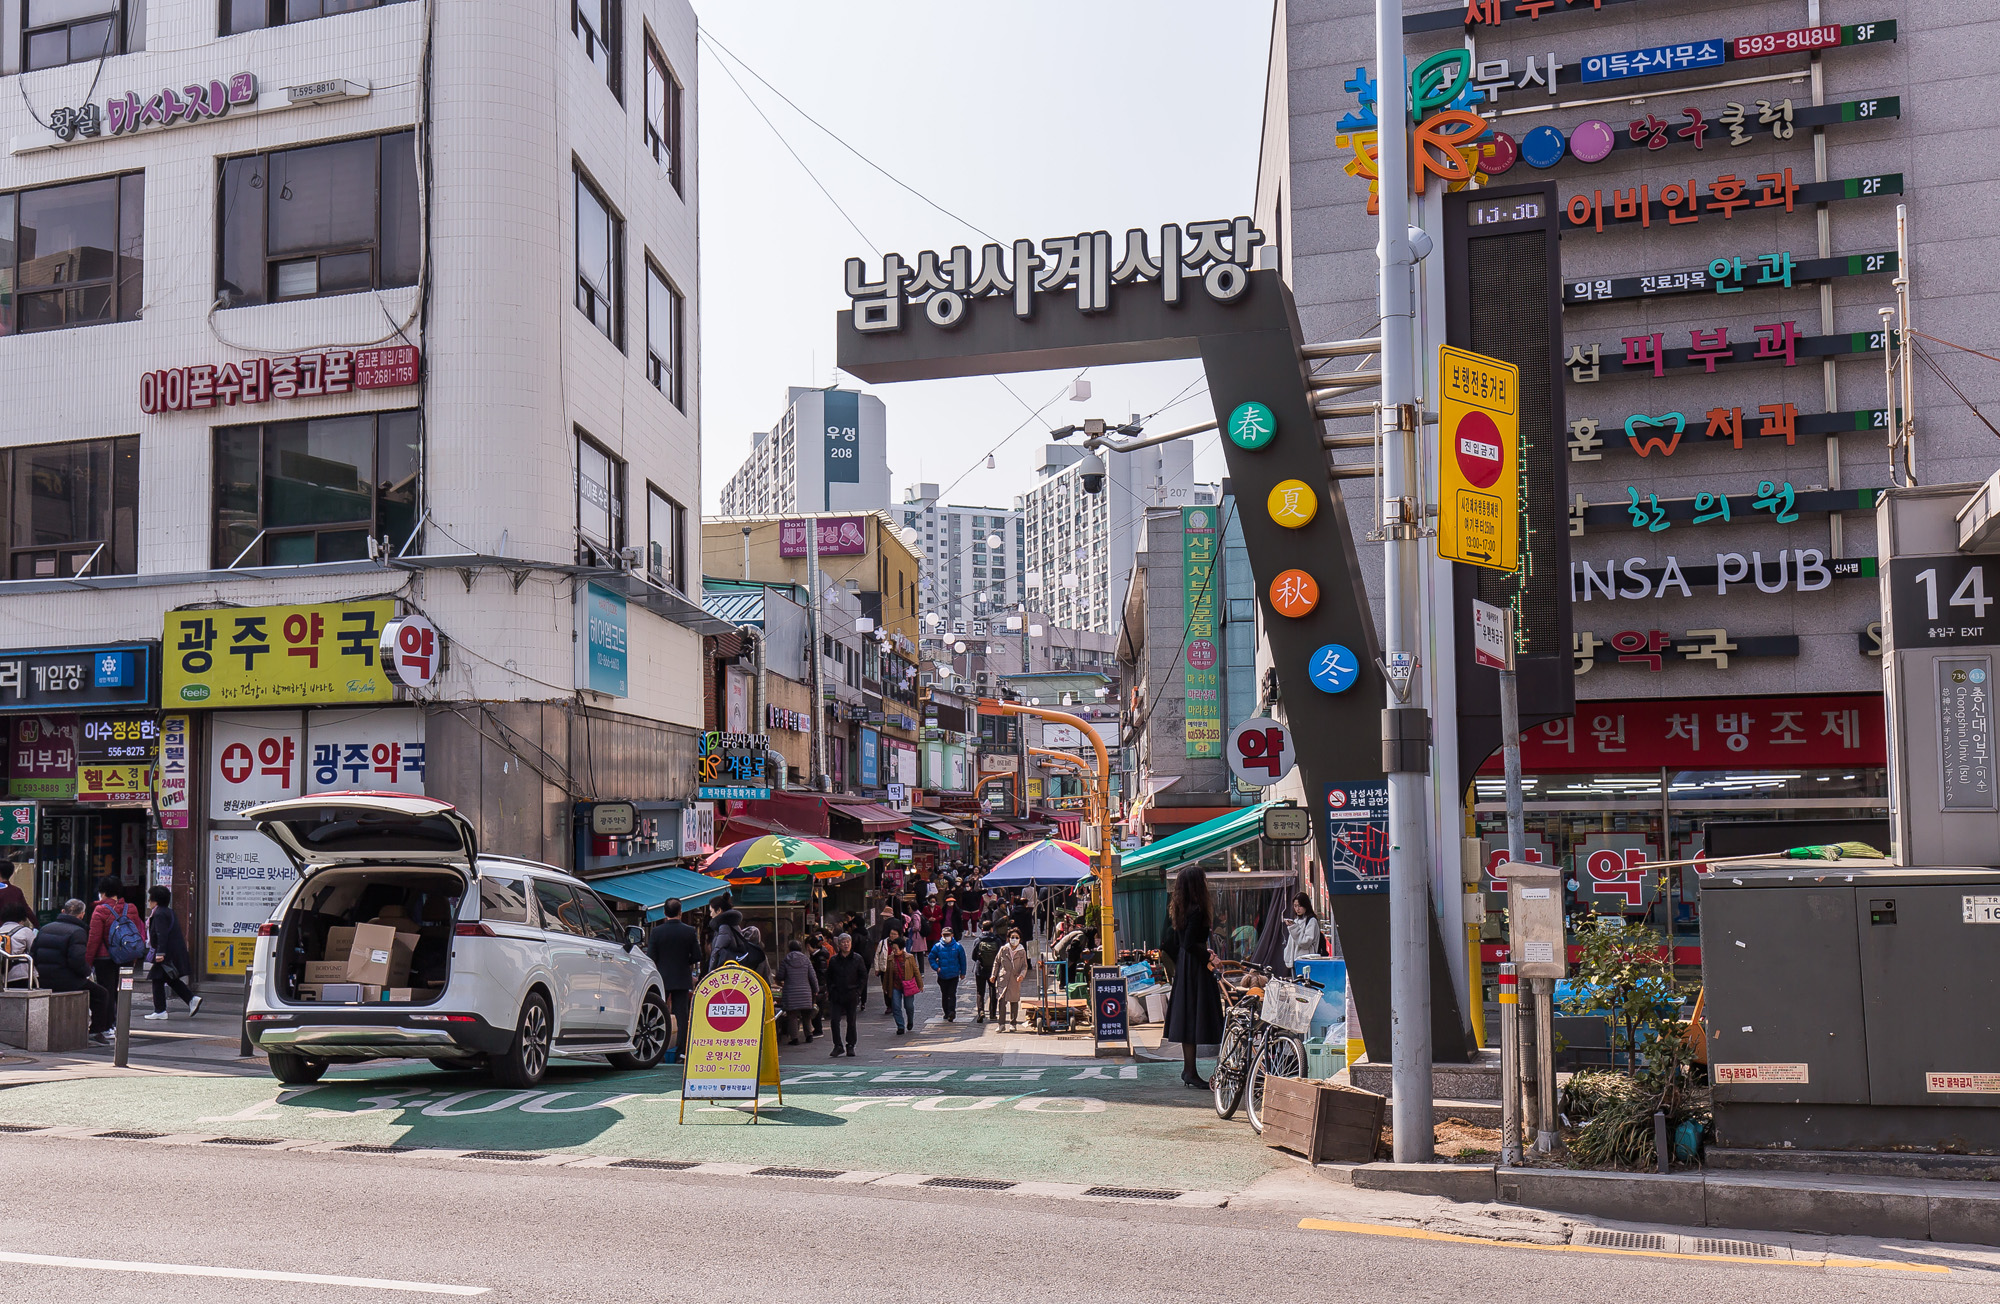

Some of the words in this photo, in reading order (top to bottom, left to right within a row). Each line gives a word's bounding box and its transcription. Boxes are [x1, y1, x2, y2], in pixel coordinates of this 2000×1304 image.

[1587, 43, 1718, 78] 이득수사무소
[1738, 27, 1836, 55] 593-8484
[1857, 24, 1875, 41] 3F
[292, 82, 336, 97] T.595-8810
[51, 104, 99, 142] 황실
[107, 80, 231, 135] 마사지
[1860, 101, 1877, 117] 3F
[1567, 167, 1799, 233] 이비인후과
[1863, 178, 1881, 194] 2F
[844, 216, 1266, 333] 남성사계시장
[1574, 280, 1613, 300] 의원
[1640, 272, 1706, 293] 진료과목
[1708, 251, 1797, 294] 안과
[1866, 255, 1885, 270] 2F
[357, 351, 378, 369] 중고폰
[380, 348, 413, 366] 매입/판매
[1621, 321, 1803, 377] 피부과
[1870, 333, 1887, 349] 2F
[140, 357, 269, 414] 아이폰수리
[270, 350, 354, 400] 중고폰
[357, 366, 413, 386] 010-2681-1759
[1452, 364, 1507, 405] 보행전용거리
[826, 425, 856, 442] 우성
[1233, 406, 1270, 442] 春
[1568, 417, 1603, 462] 훈
[1705, 403, 1799, 449] 치과
[831, 447, 853, 459] 208
[1464, 440, 1496, 460] 진입금지
[1170, 488, 1187, 498] 207
[1276, 486, 1307, 518] 夏
[1627, 480, 1799, 532] 한의원
[1717, 549, 1833, 596] PUB
[1188, 536, 1214, 638] 샤브샤브전문점
[1275, 576, 1312, 609] 秋
[1915, 565, 1994, 620] 14
[177, 610, 379, 674] 광주약국
[1927, 627, 1956, 638] 출입구
[1961, 626, 1984, 637] EXIT
[399, 625, 434, 680] 약
[1192, 641, 1211, 650] 무한
[1192, 650, 1211, 659] 리필
[31, 664, 83, 692] 게임장
[1315, 649, 1354, 686] 冬
[1393, 666, 1409, 677] 3-13
[1970, 672, 1985, 680] 432
[221, 687, 237, 699] 항상
[241, 681, 267, 699] 건강이
[272, 681, 307, 696] 함께하길
[309, 683, 335, 694] 바라요
[1187, 674, 1216, 685] 마라탕
[181, 687, 209, 698] feels
[1955, 686, 1969, 738] Chongshin
[721, 731, 770, 751] 남성사계시장
[1665, 709, 1861, 752] 처방조제
[108, 747, 145, 757] 556-8275
[164, 719, 186, 774] 경희헬스
[1237, 727, 1285, 778] 약
[1959, 739, 1970, 763] Univ.
[18, 748, 73, 773] 피부과
[258, 735, 295, 790] 약
[312, 741, 426, 786] 광주약국
[84, 769, 125, 792] 헬스
[128, 767, 139, 791] 경희
[161, 778, 186, 789] 24시간
[1959, 764, 1971, 784] (Isu)
[106, 793, 151, 801] T.592-221
[161, 789, 185, 808] OPEN
[1350, 798, 1366, 807] 주변
[215, 852, 243, 864] 현대인의
[214, 866, 266, 880] 임팩타민으로
[267, 866, 297, 881] 맞서라!
[1586, 847, 1648, 906] 약
[700, 973, 760, 998] 보행전용거리
[1097, 985, 1124, 994] 주차금지
[711, 1005, 745, 1016] 진입금지
[692, 1038, 713, 1047] 시간제
[715, 1038, 758, 1047] 차량통행제한
[705, 1051, 742, 1061] 운영시간
[694, 1064, 717, 1073] 13:00
[728, 1064, 751, 1073] 17:00
[1719, 1068, 1732, 1079] 무단
[1733, 1068, 1758, 1079] 굴착금지
[1931, 1077, 1945, 1088] 무단
[1946, 1077, 1973, 1089] 굴착금지
